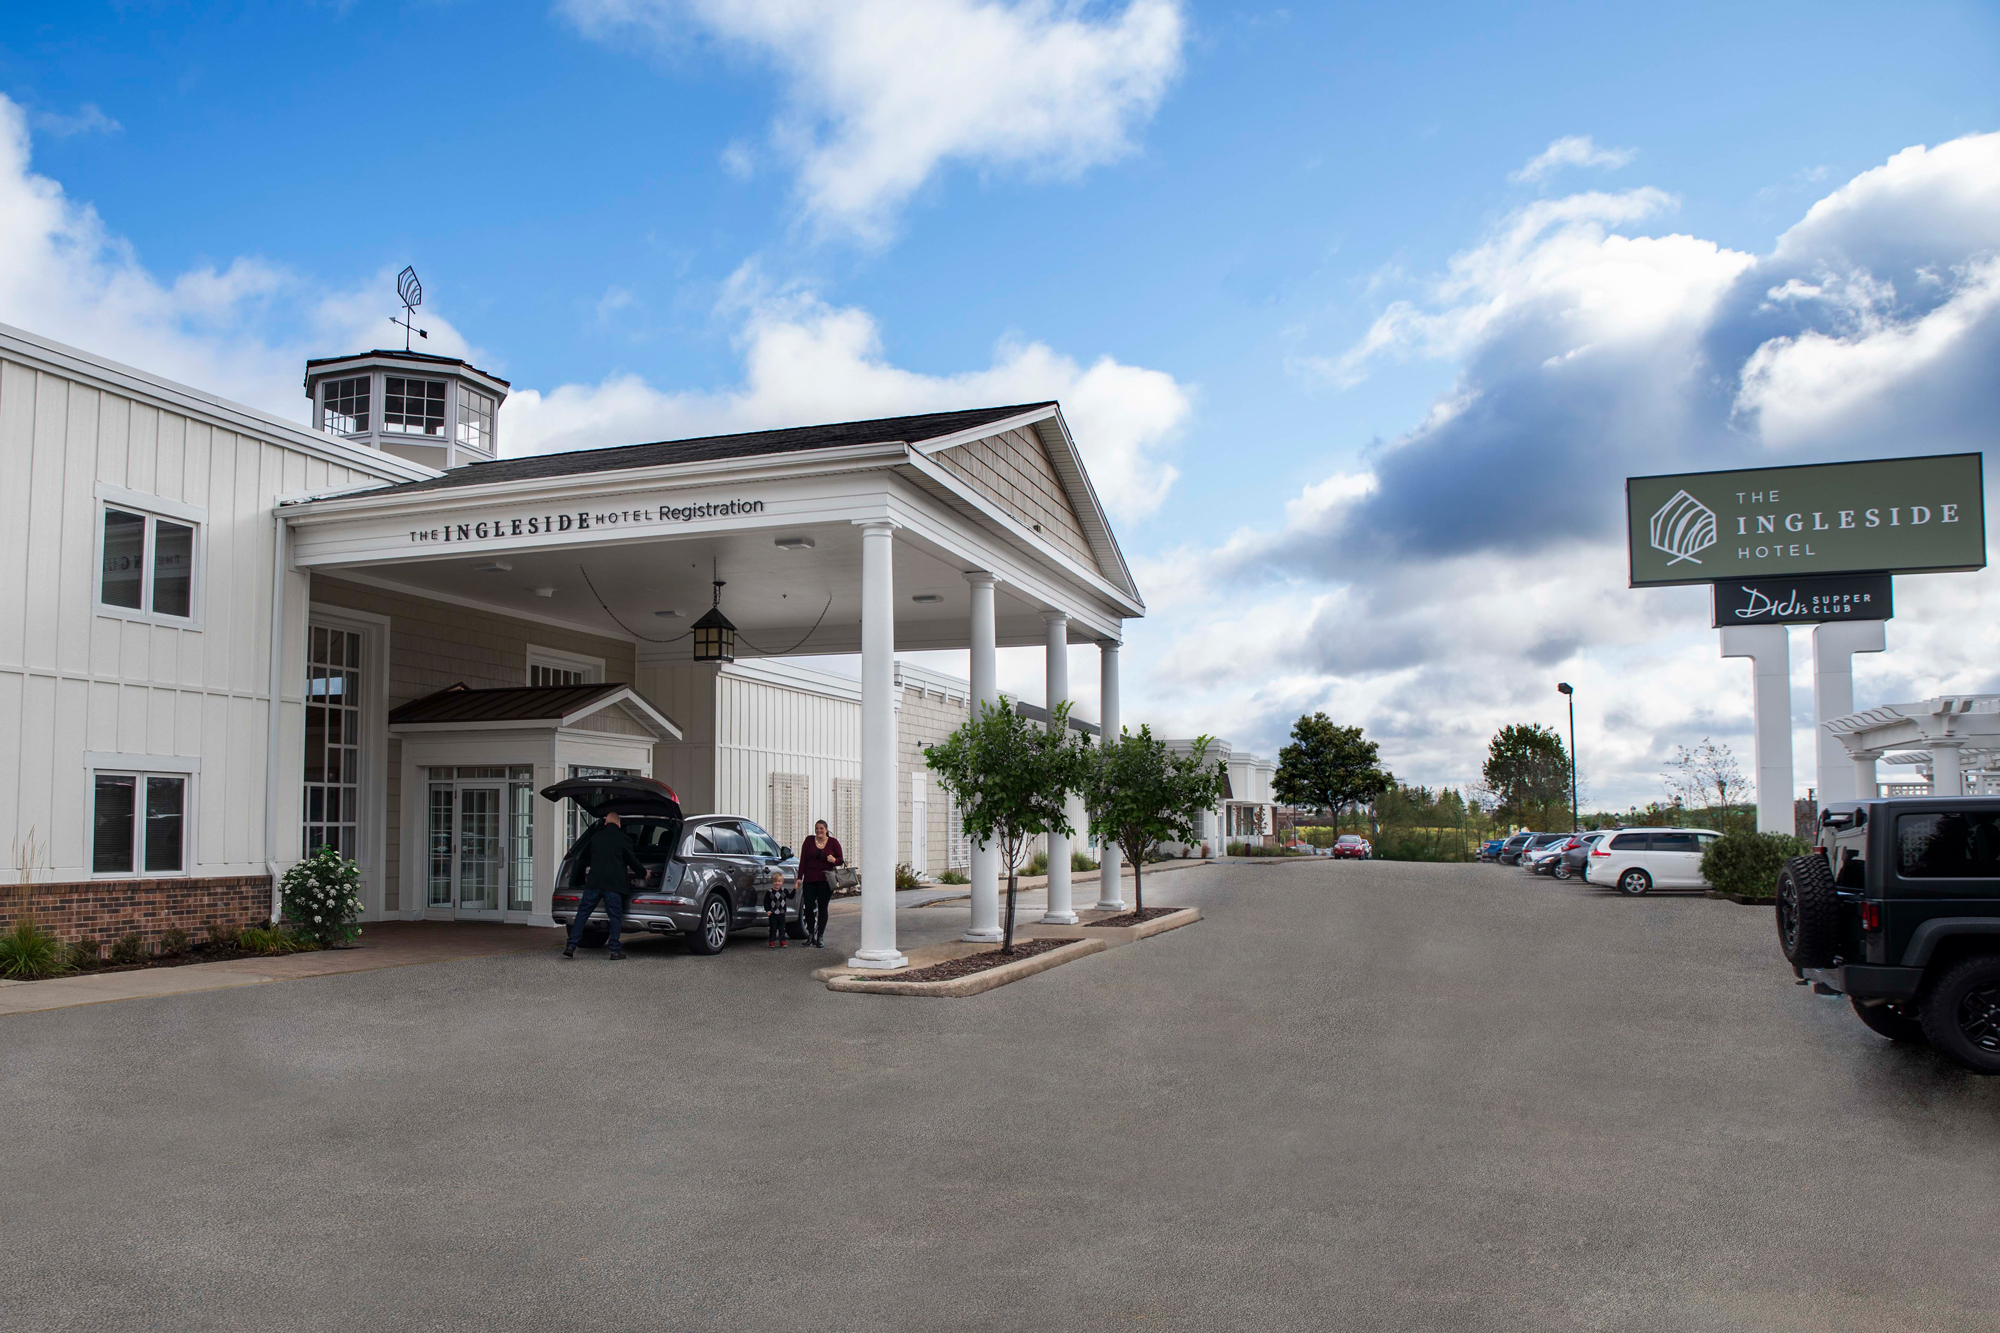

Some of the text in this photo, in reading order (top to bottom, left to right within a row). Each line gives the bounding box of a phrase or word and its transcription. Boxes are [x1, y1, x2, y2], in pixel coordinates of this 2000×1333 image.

[1736, 490, 1780, 504] THE
[410, 498, 764, 542] THE INGLESIDE HOTEL Registration
[1737, 504, 1958, 535] INGLESIDE
[1738, 543, 1816, 559] HOTEL
[1735, 586, 1808, 618] Didi's
[1812, 594, 1871, 605] SUPPER
[1812, 604, 1851, 614] CLUB
